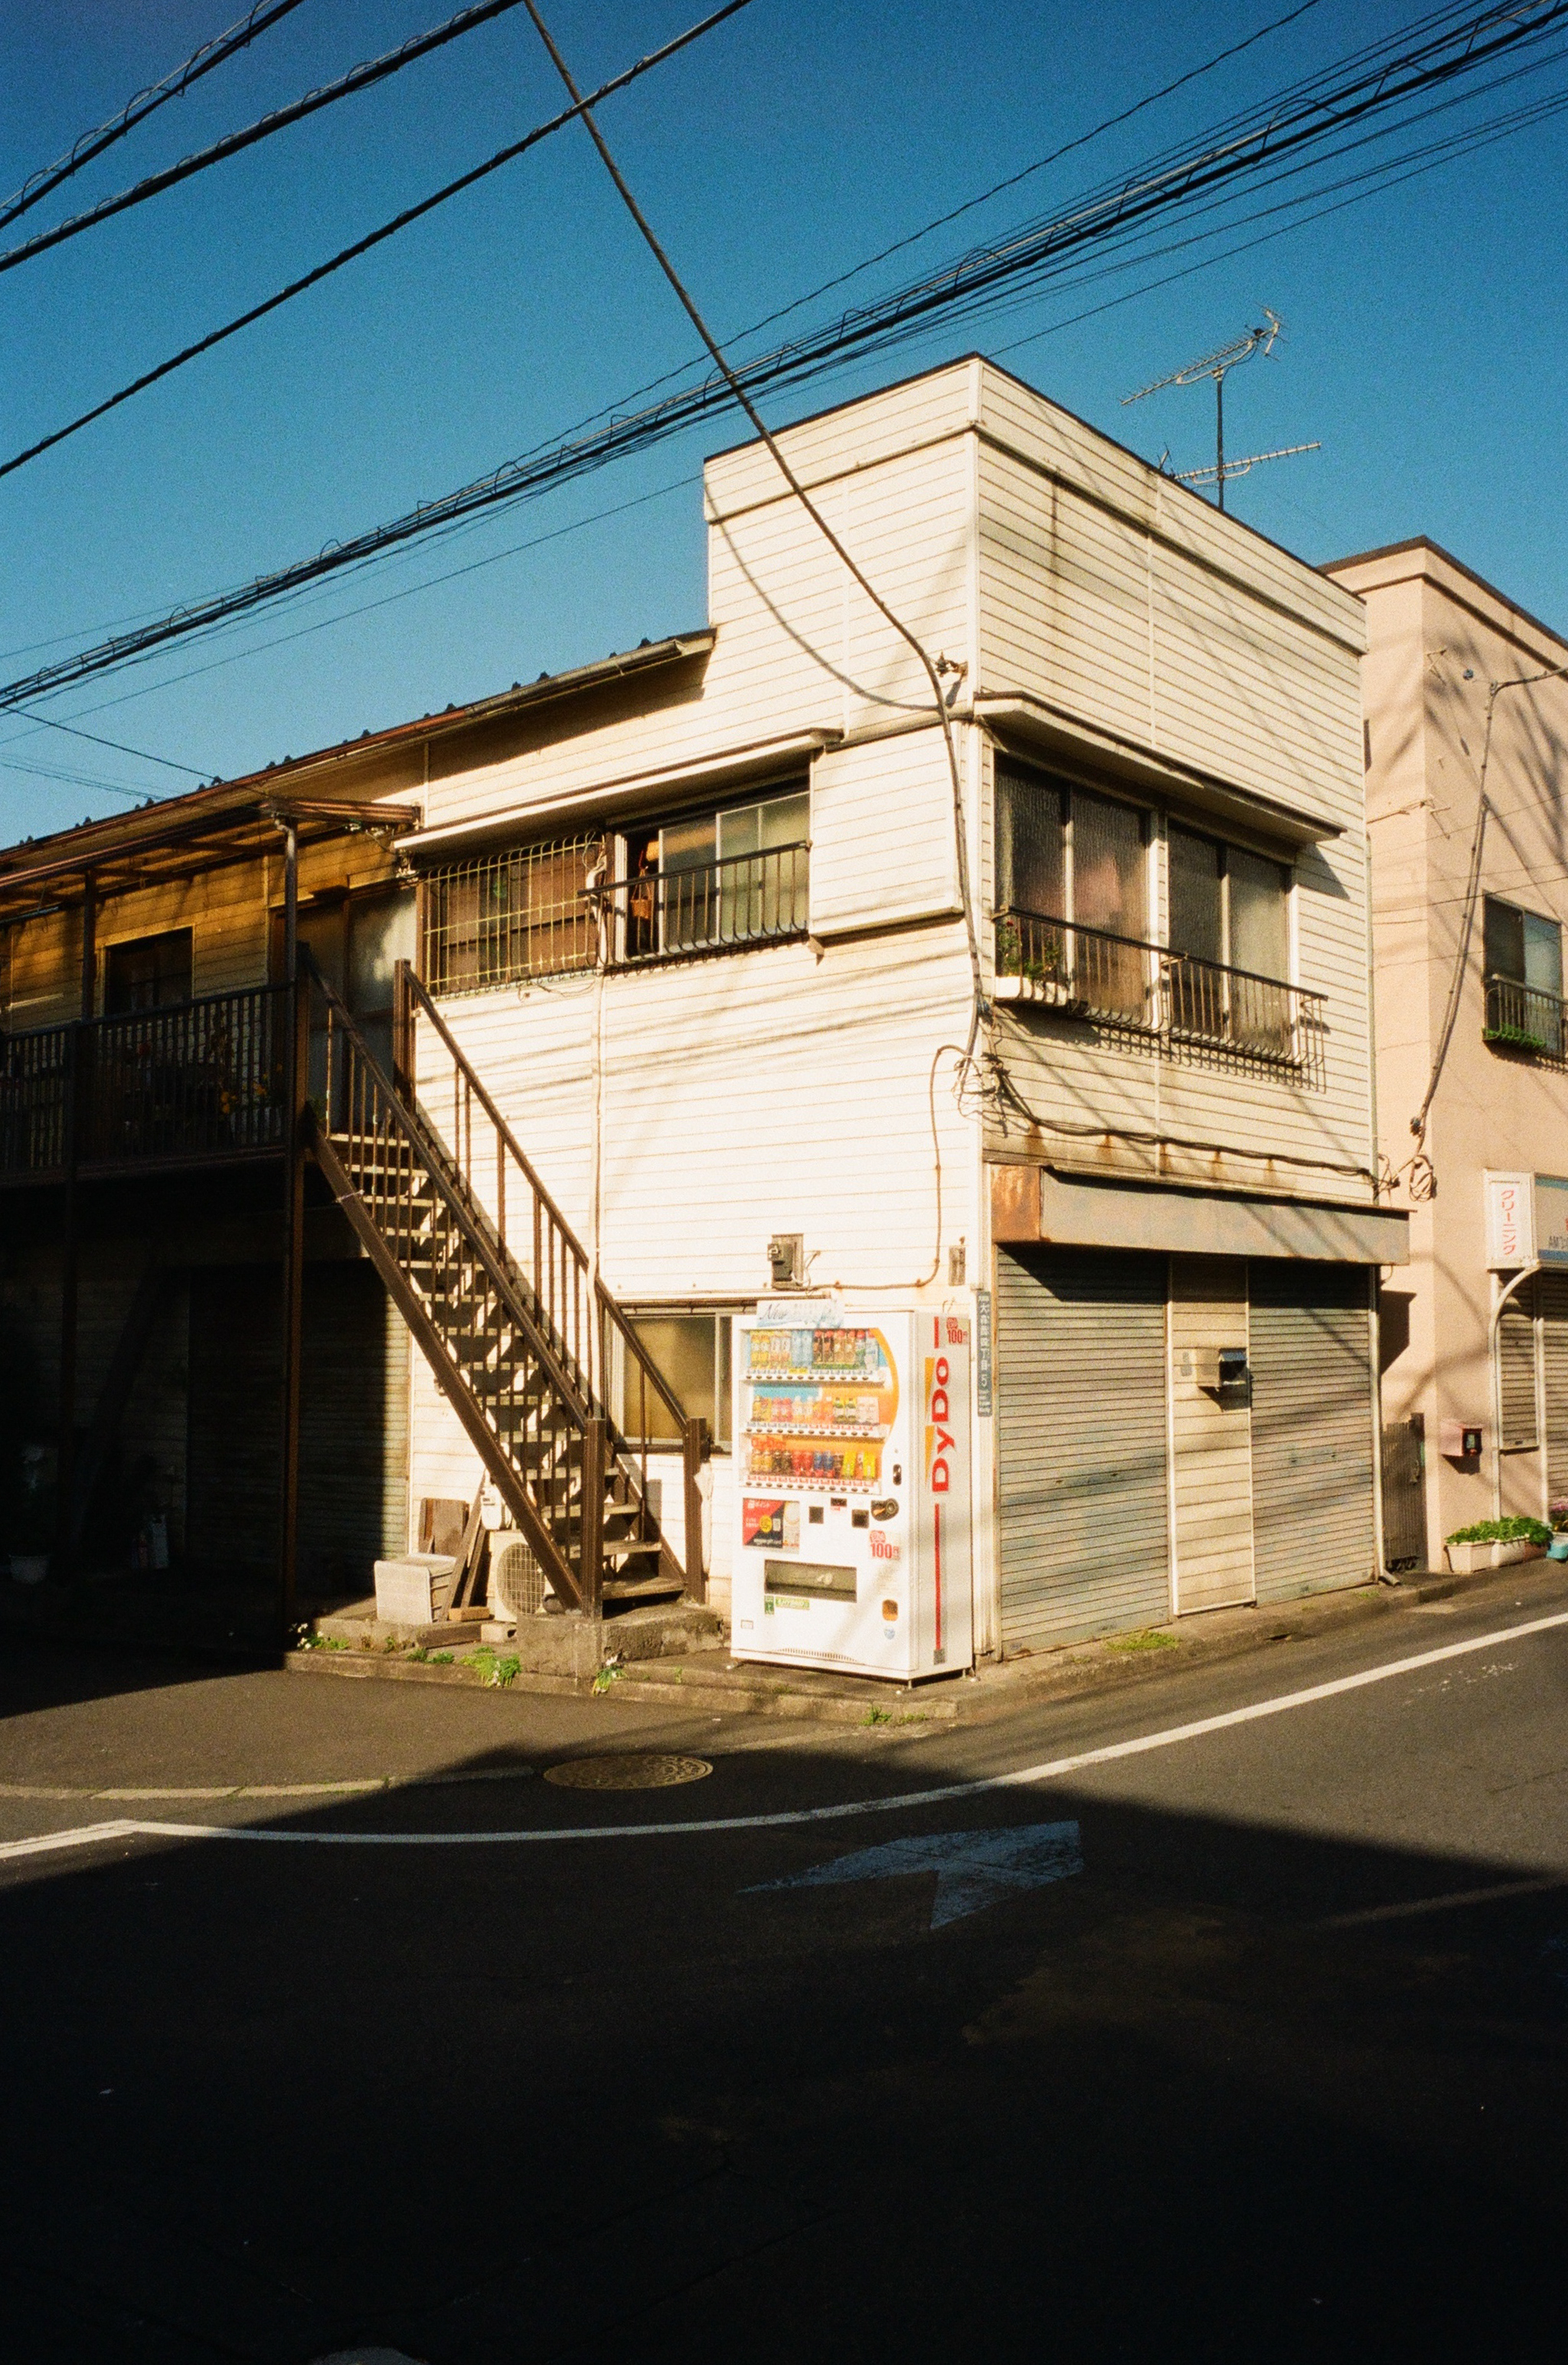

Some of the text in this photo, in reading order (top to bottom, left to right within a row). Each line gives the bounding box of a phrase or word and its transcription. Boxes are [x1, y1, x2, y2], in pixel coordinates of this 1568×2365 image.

[1501, 1190, 1516, 1255] クリーニング
[981, 1374, 988, 1387] 5
[931, 1357, 956, 1492] DyDo
